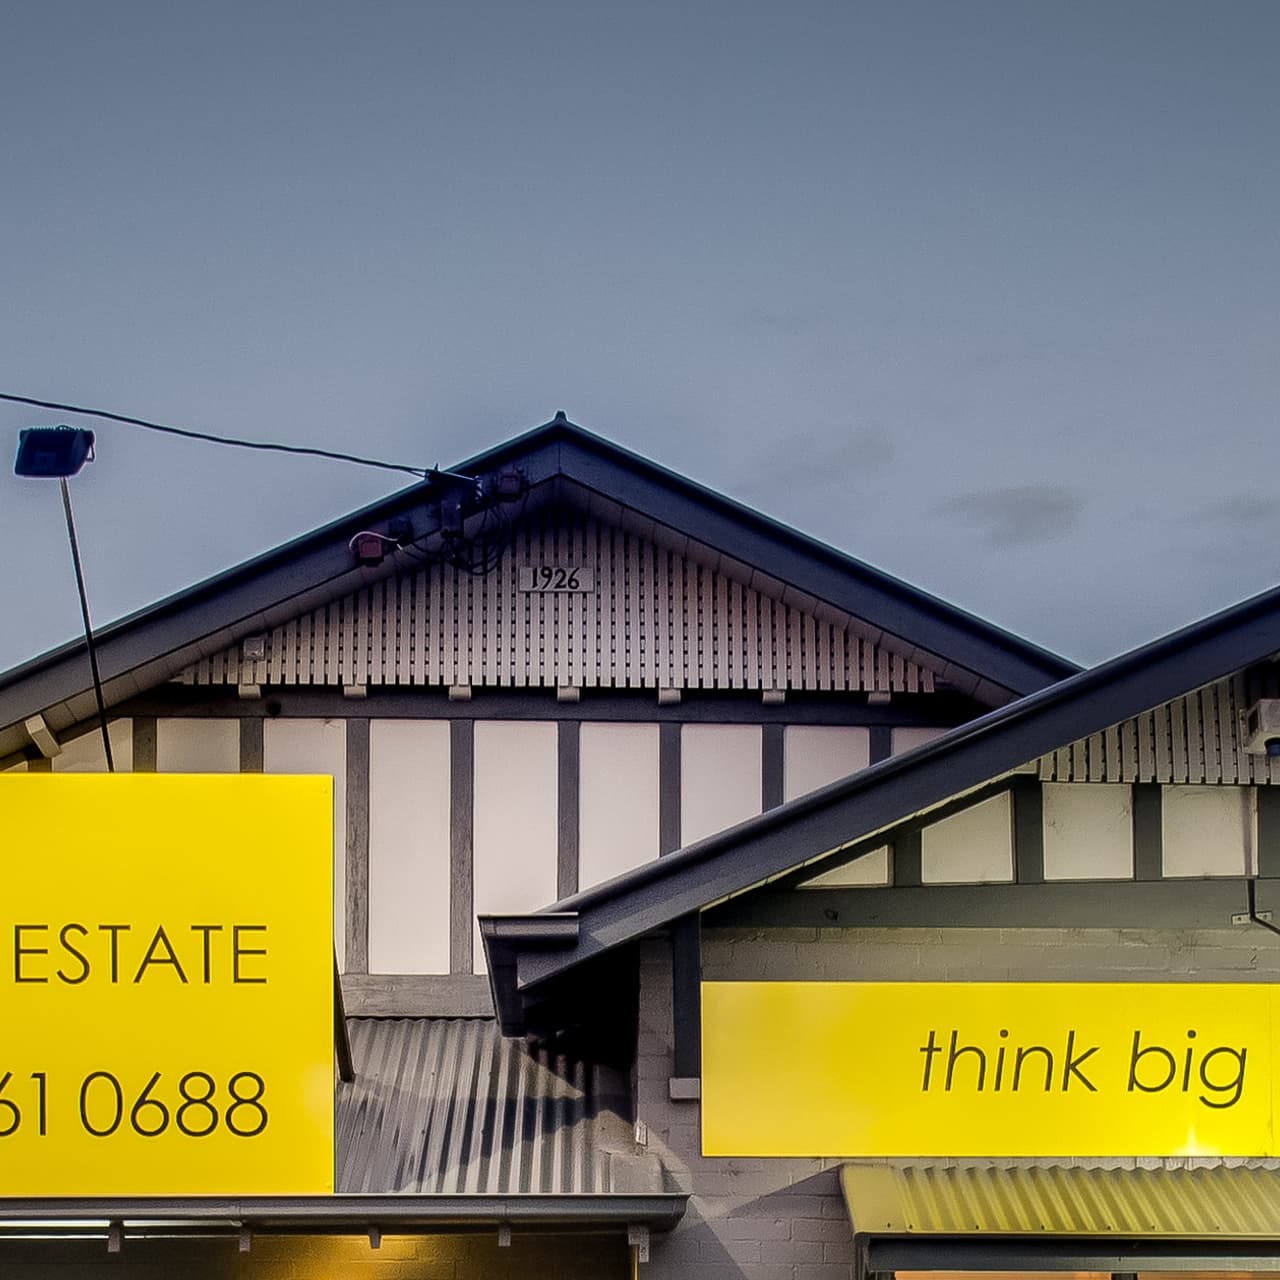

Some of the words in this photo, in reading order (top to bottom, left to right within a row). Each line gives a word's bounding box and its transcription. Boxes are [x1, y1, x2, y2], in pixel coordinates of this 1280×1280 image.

[531, 566, 580, 590] 1926
[13, 923, 268, 985] ESTATE
[919, 1028, 1101, 1093] think
[1126, 1028, 1248, 1109] big
[78, 1070, 269, 1137] 0688
